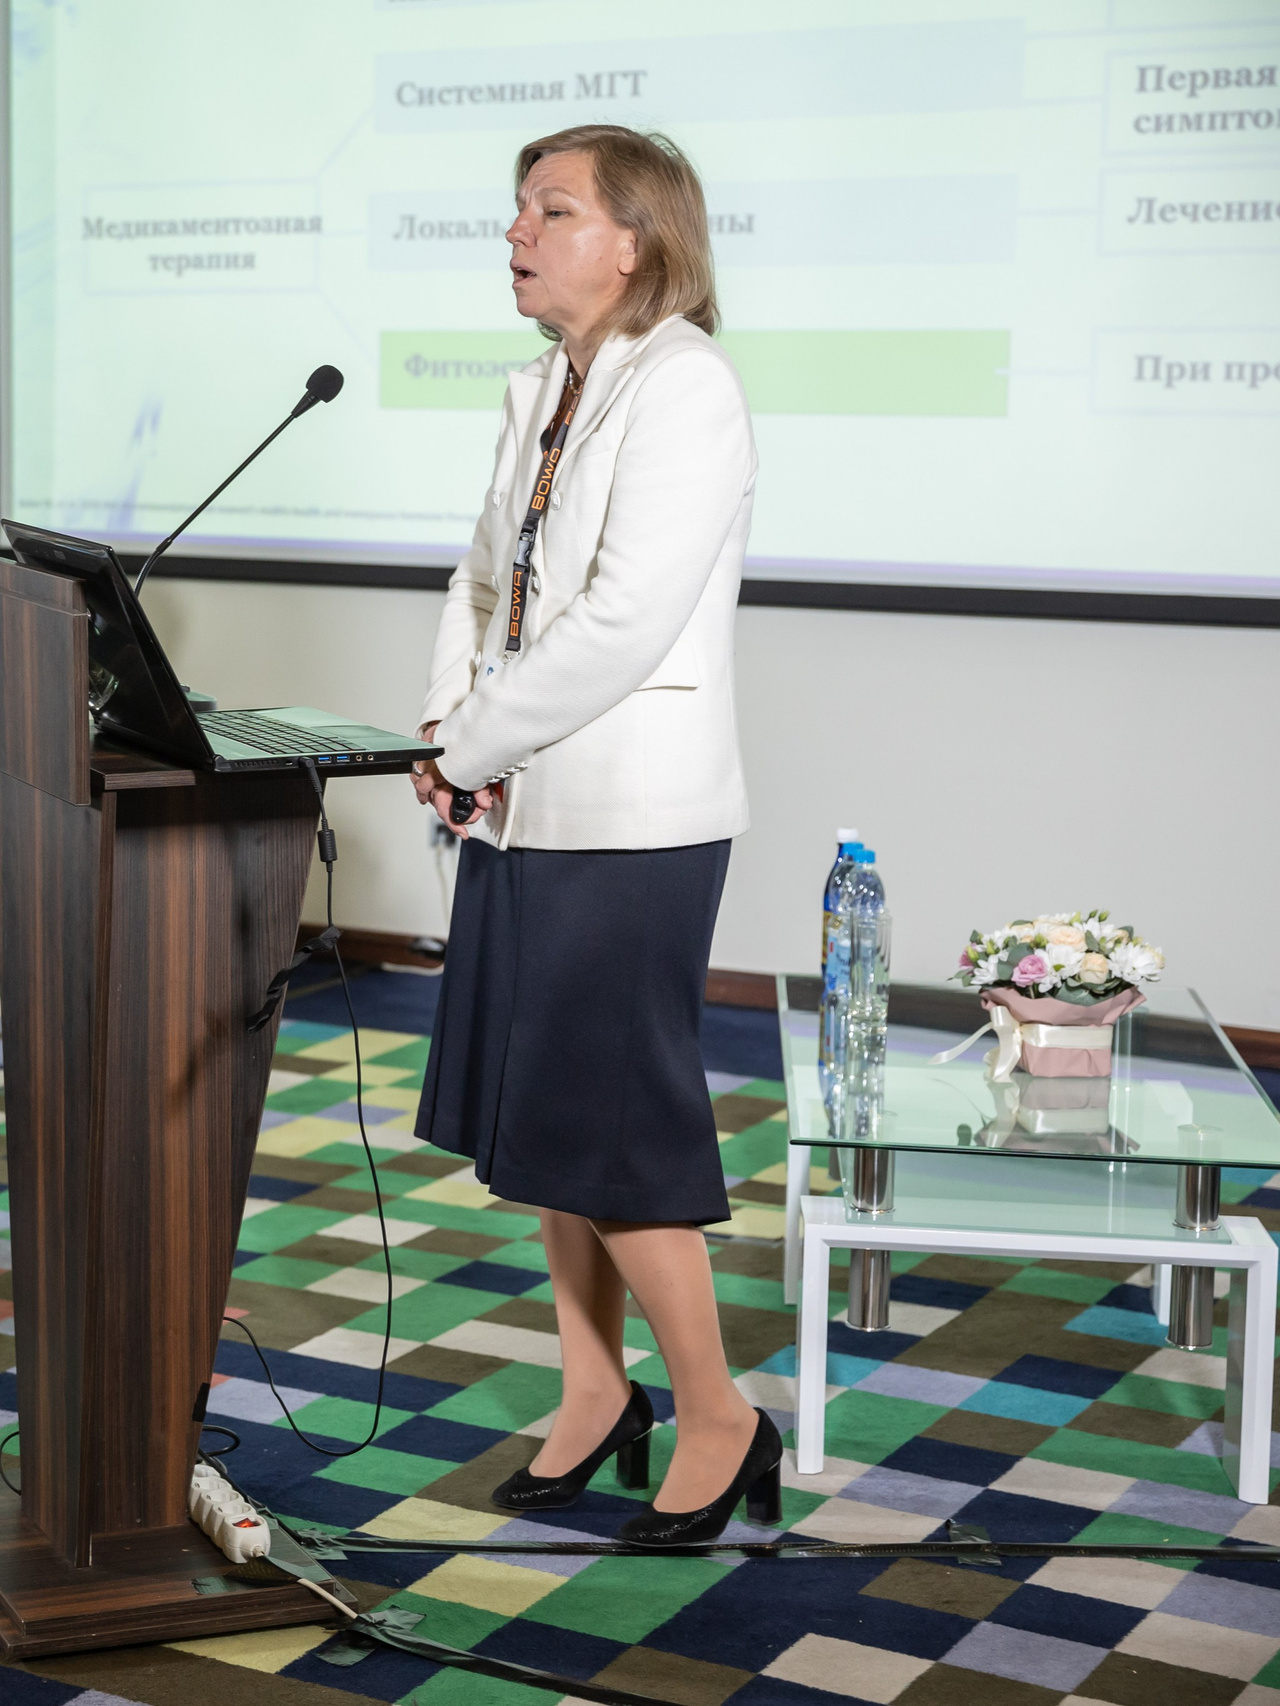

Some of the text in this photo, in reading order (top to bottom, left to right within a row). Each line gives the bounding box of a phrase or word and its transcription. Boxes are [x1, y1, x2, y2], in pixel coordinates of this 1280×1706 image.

[396, 69, 647, 107] Системная МГТ
[1136, 64, 1277, 98] Первая
[82, 215, 323, 242] Медикаментозная
[393, 214, 507, 241] Локаль
[149, 252, 256, 278] терапия
[1134, 354, 1212, 389] При
[510, 571, 522, 637] BOWA
